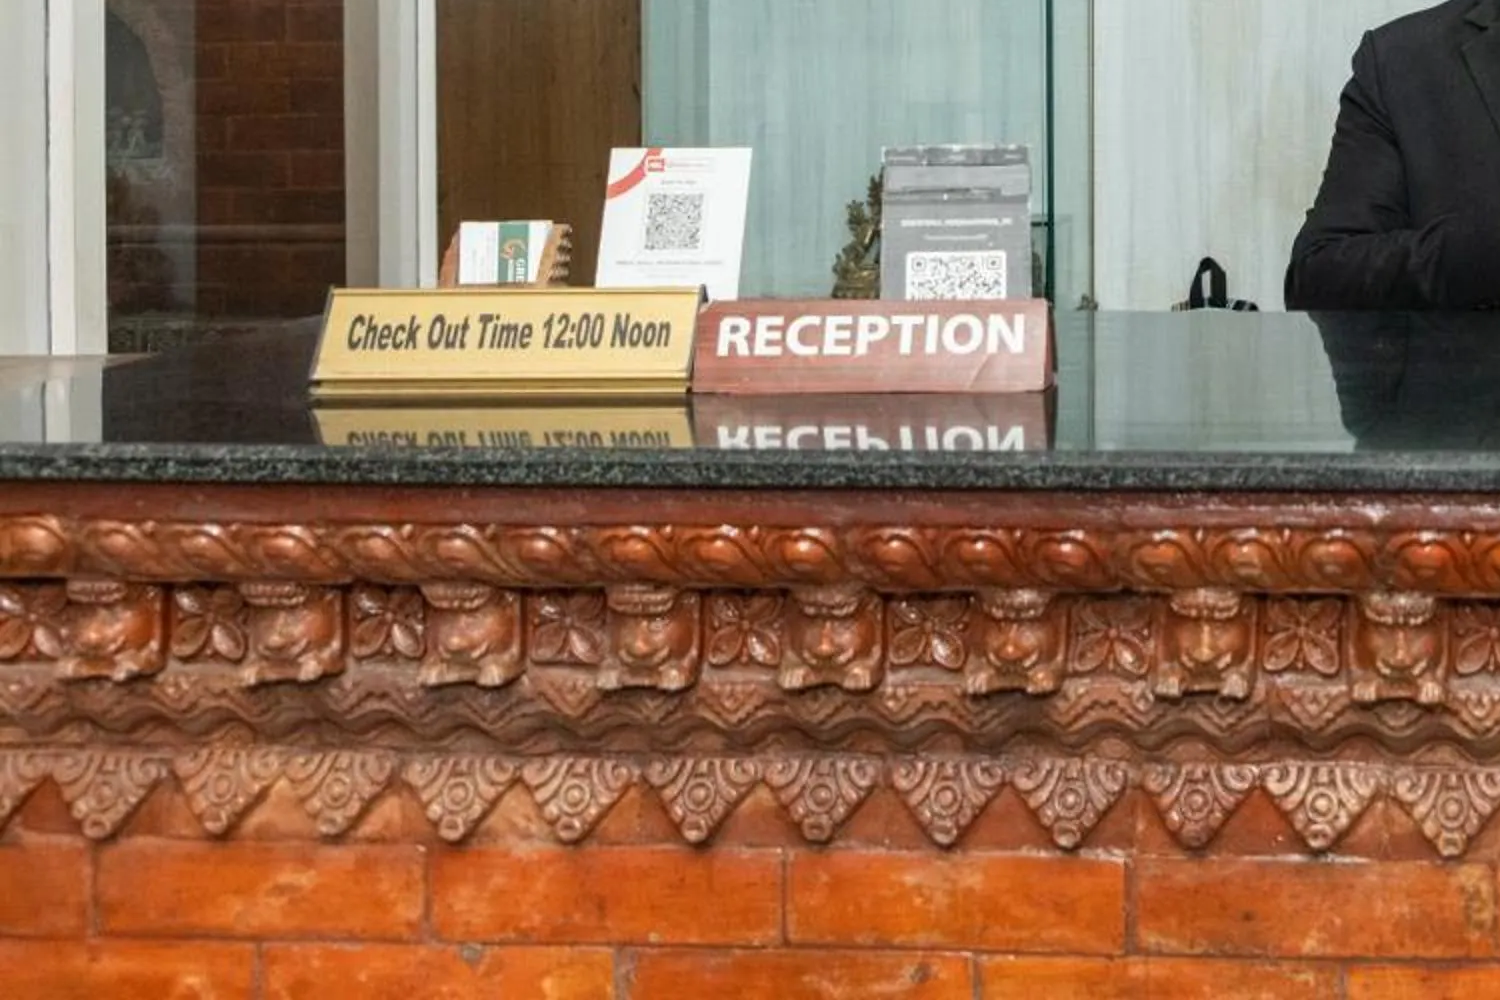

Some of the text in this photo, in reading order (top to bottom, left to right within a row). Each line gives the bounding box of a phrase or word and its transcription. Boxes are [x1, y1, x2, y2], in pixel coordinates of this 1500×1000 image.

[347, 313, 671, 350] Check Out Time 12:00 Noon
[716, 314, 1026, 357] RECEPTION
